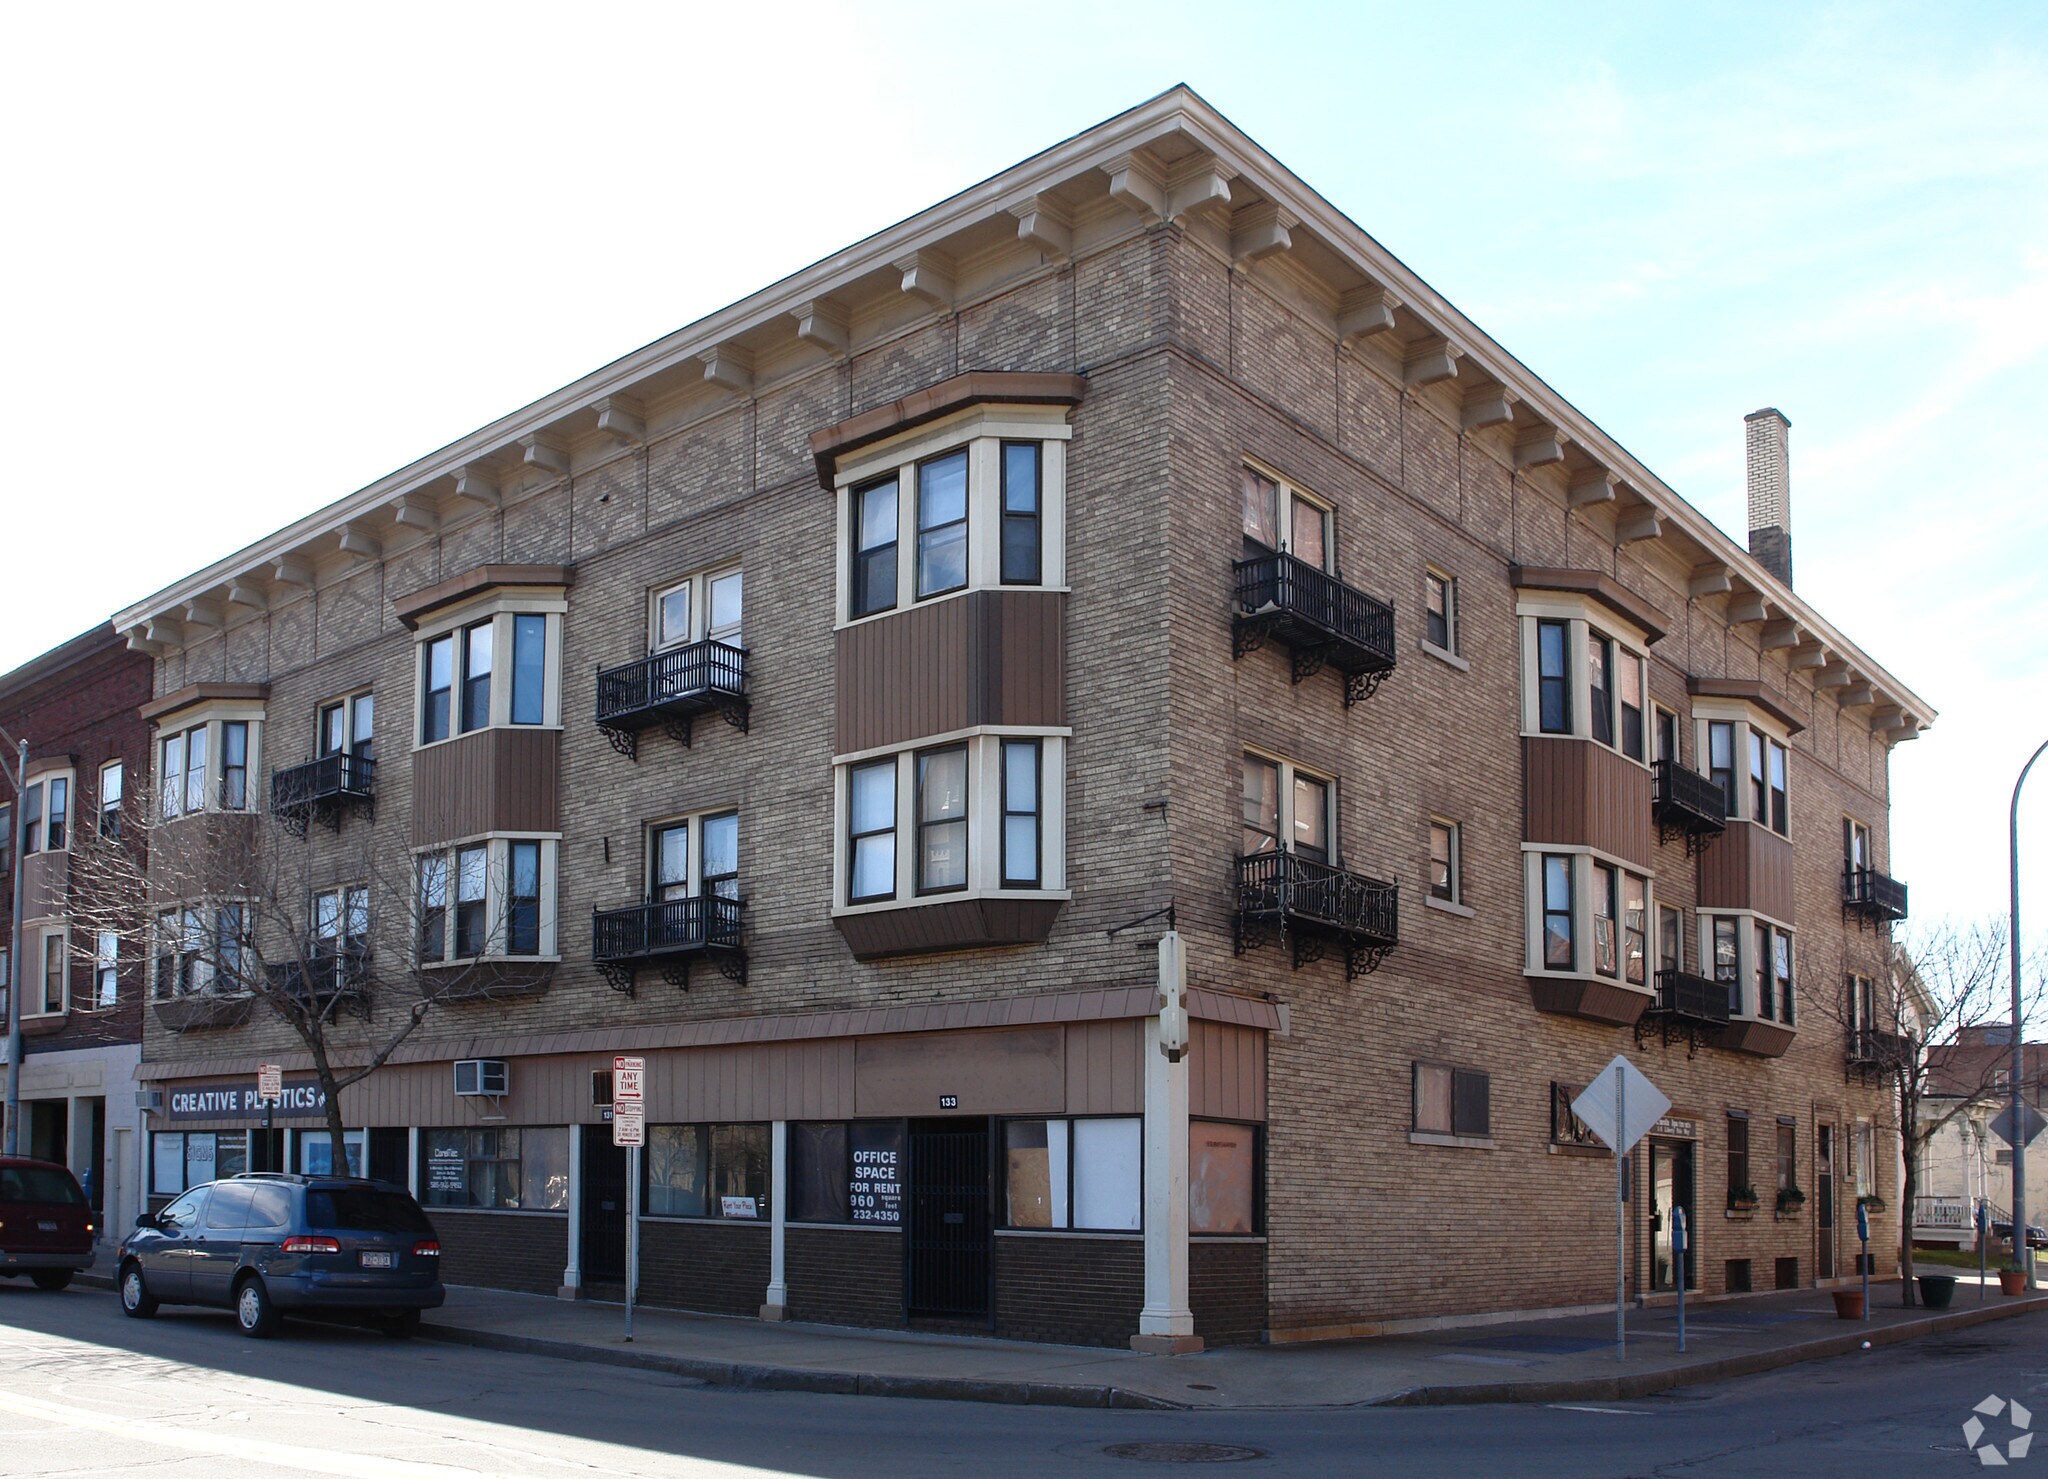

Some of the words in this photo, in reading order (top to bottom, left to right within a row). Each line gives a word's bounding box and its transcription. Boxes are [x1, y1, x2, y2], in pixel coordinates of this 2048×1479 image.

[616, 1060, 625, 1068] NO
[621, 1072, 638, 1080] ANY
[620, 1082, 638, 1090] TIME
[172, 1090, 237, 1113] CREATIVE
[941, 1097, 956, 1107] 133
[616, 1104, 625, 1112] NO
[853, 1150, 897, 1164] OFFICE
[855, 1166, 895, 1179] SPACE
[850, 1182, 869, 1192] FOR
[874, 1183, 901, 1194] RENT
[850, 1194, 874, 1207] 960
[853, 1209, 899, 1221] 232-4350
